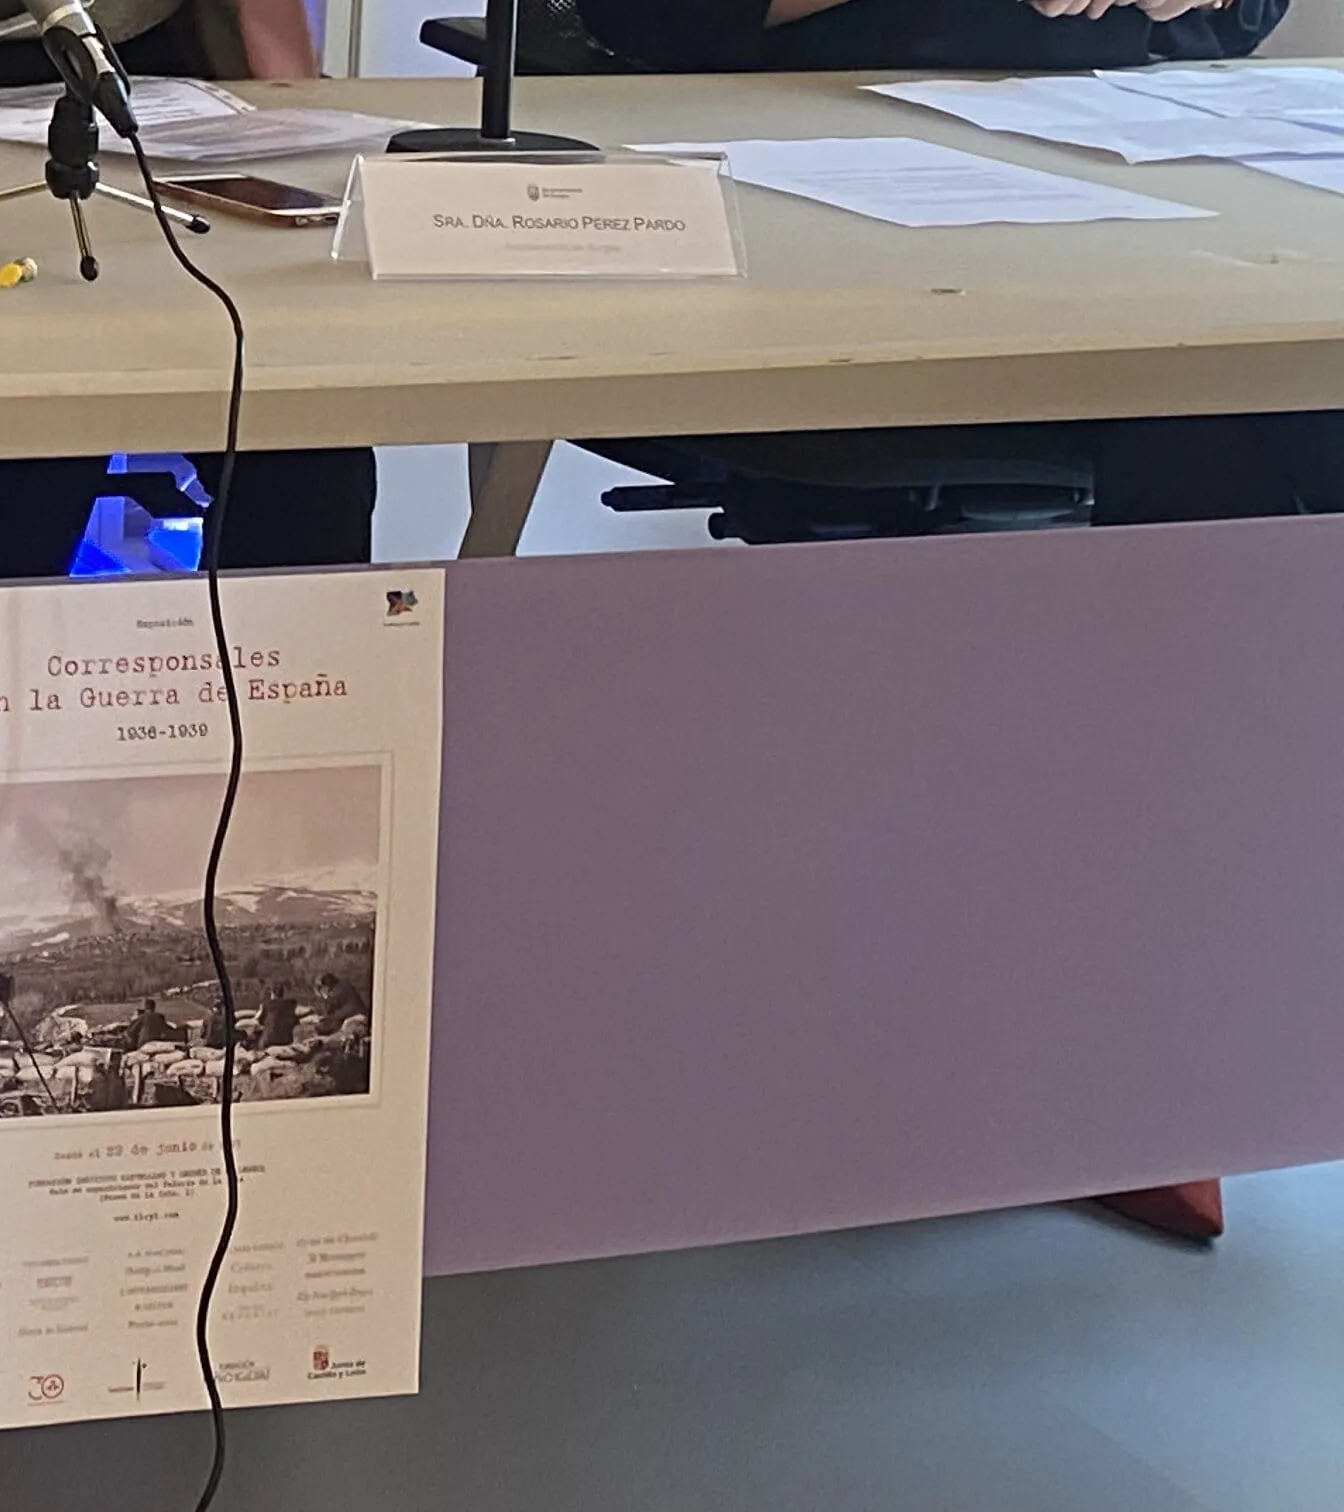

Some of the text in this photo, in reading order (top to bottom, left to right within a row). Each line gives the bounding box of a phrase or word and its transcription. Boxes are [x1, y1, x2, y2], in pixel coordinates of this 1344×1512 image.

[512, 215, 578, 230] ROSARIO
[634, 216, 686, 232] PARDO
[29, 689, 62, 712] la
[79, 686, 180, 709] Guerra
[198, 681, 228, 704] de
[248, 674, 348, 705] España
